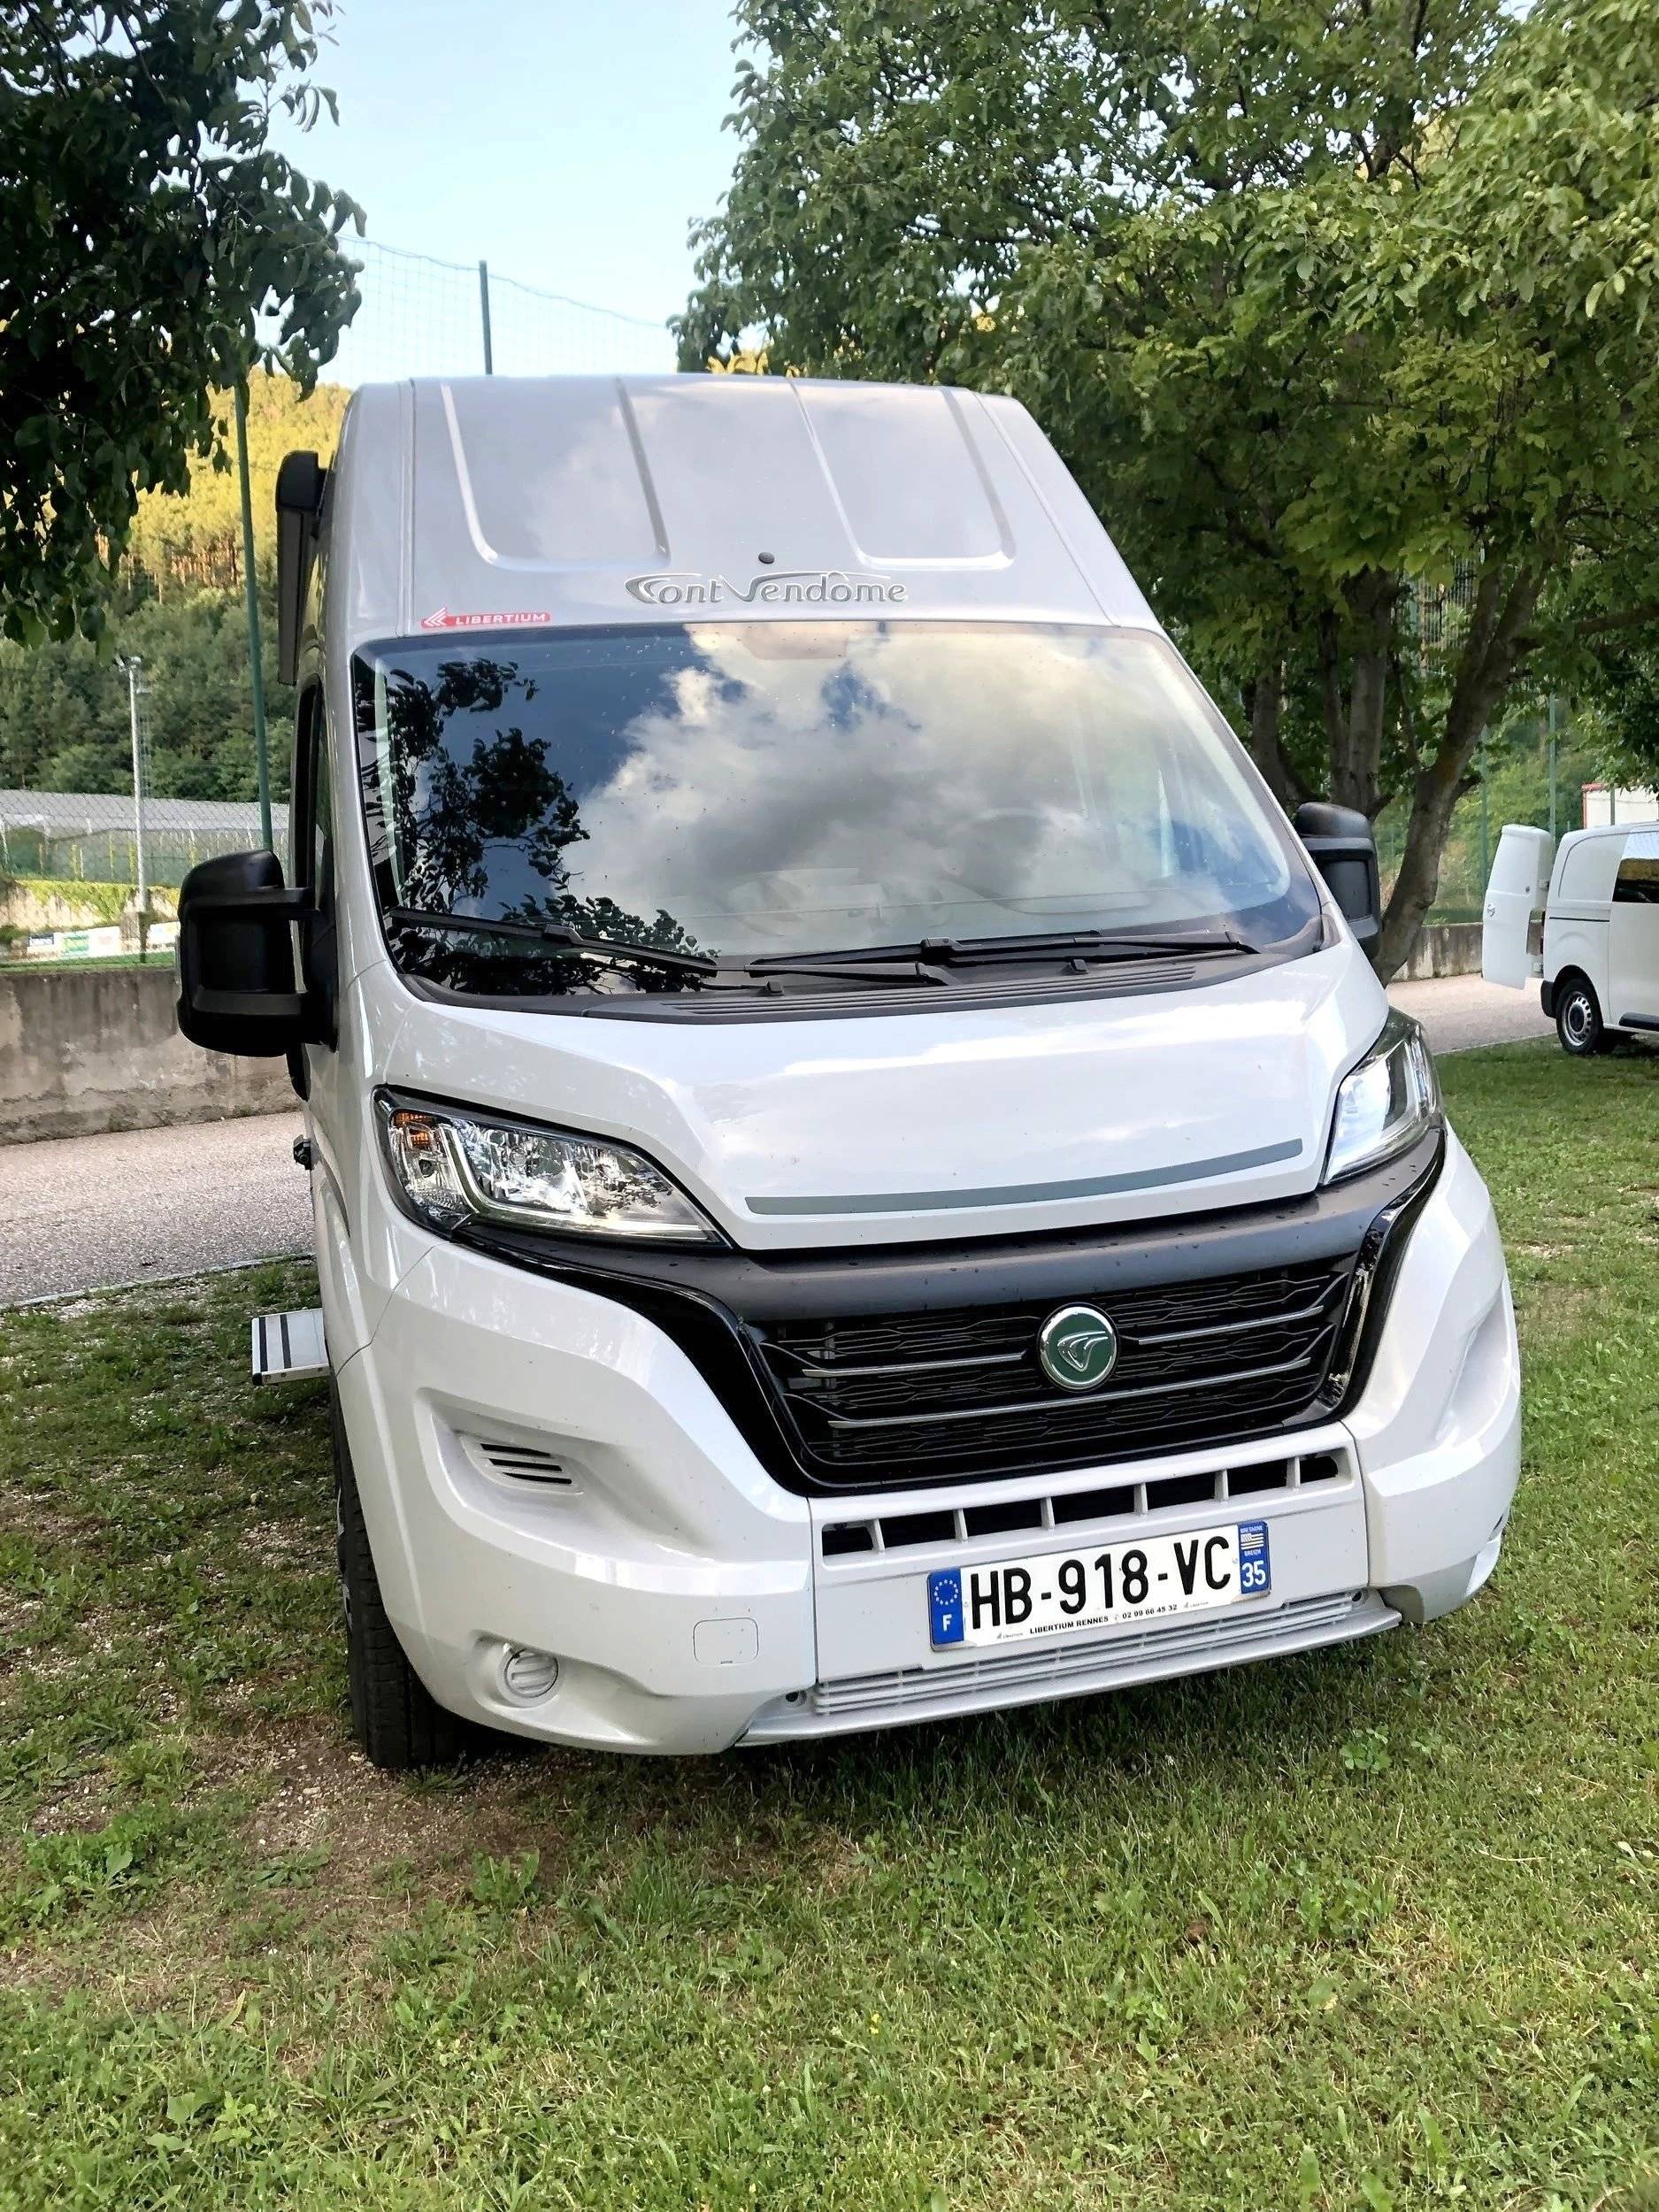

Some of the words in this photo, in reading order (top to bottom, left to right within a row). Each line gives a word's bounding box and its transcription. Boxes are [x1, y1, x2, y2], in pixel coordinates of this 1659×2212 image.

[455, 612, 546, 626] LIBERTIUM
[970, 1535, 1232, 1630] HB-918-VC
[1241, 1560, 1267, 1588] 35
[942, 1613, 953, 1632] F
[1029, 1621, 1074, 1634] LIBERTIUM
[1076, 1615, 1109, 1627] RENNES
